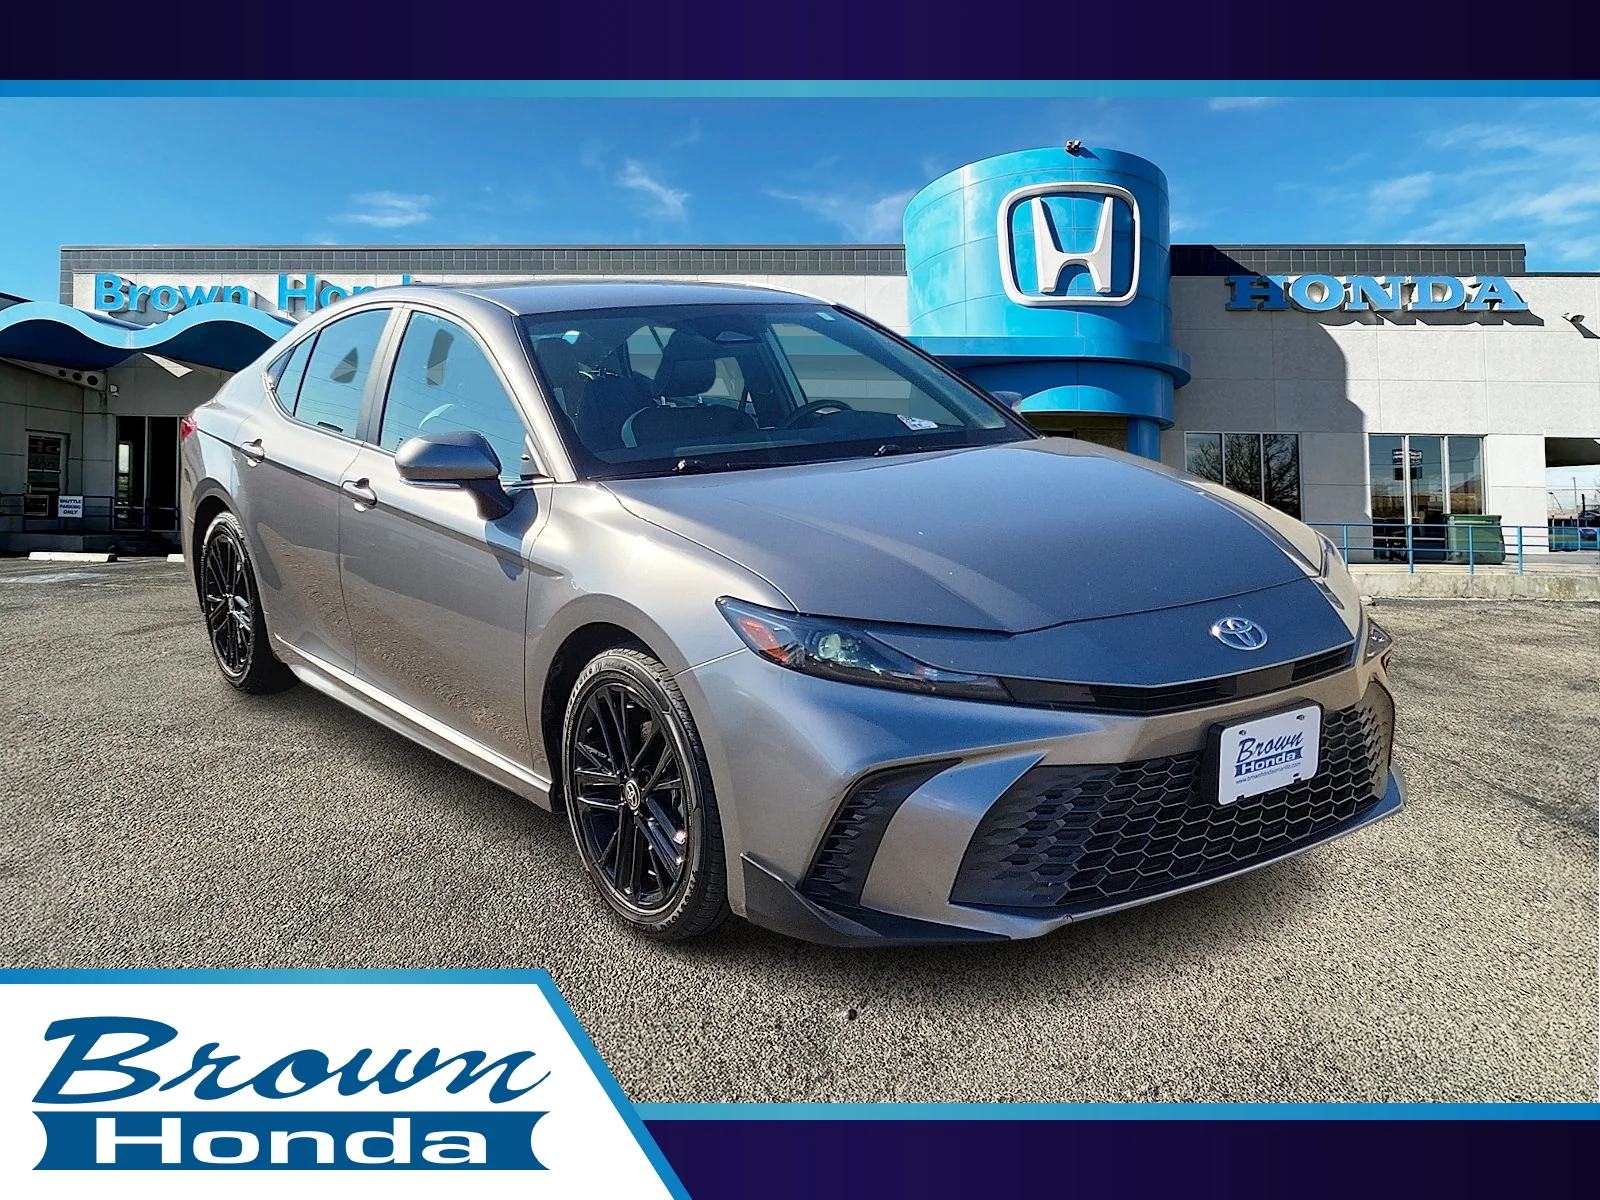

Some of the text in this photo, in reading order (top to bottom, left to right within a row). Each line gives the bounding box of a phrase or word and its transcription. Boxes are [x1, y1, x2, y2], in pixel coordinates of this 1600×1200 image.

[95, 273, 249, 311] Brown
[1227, 275, 1528, 310] HONDA
[1236, 732, 1304, 764] Brown
[1241, 752, 1296, 775] Honda
